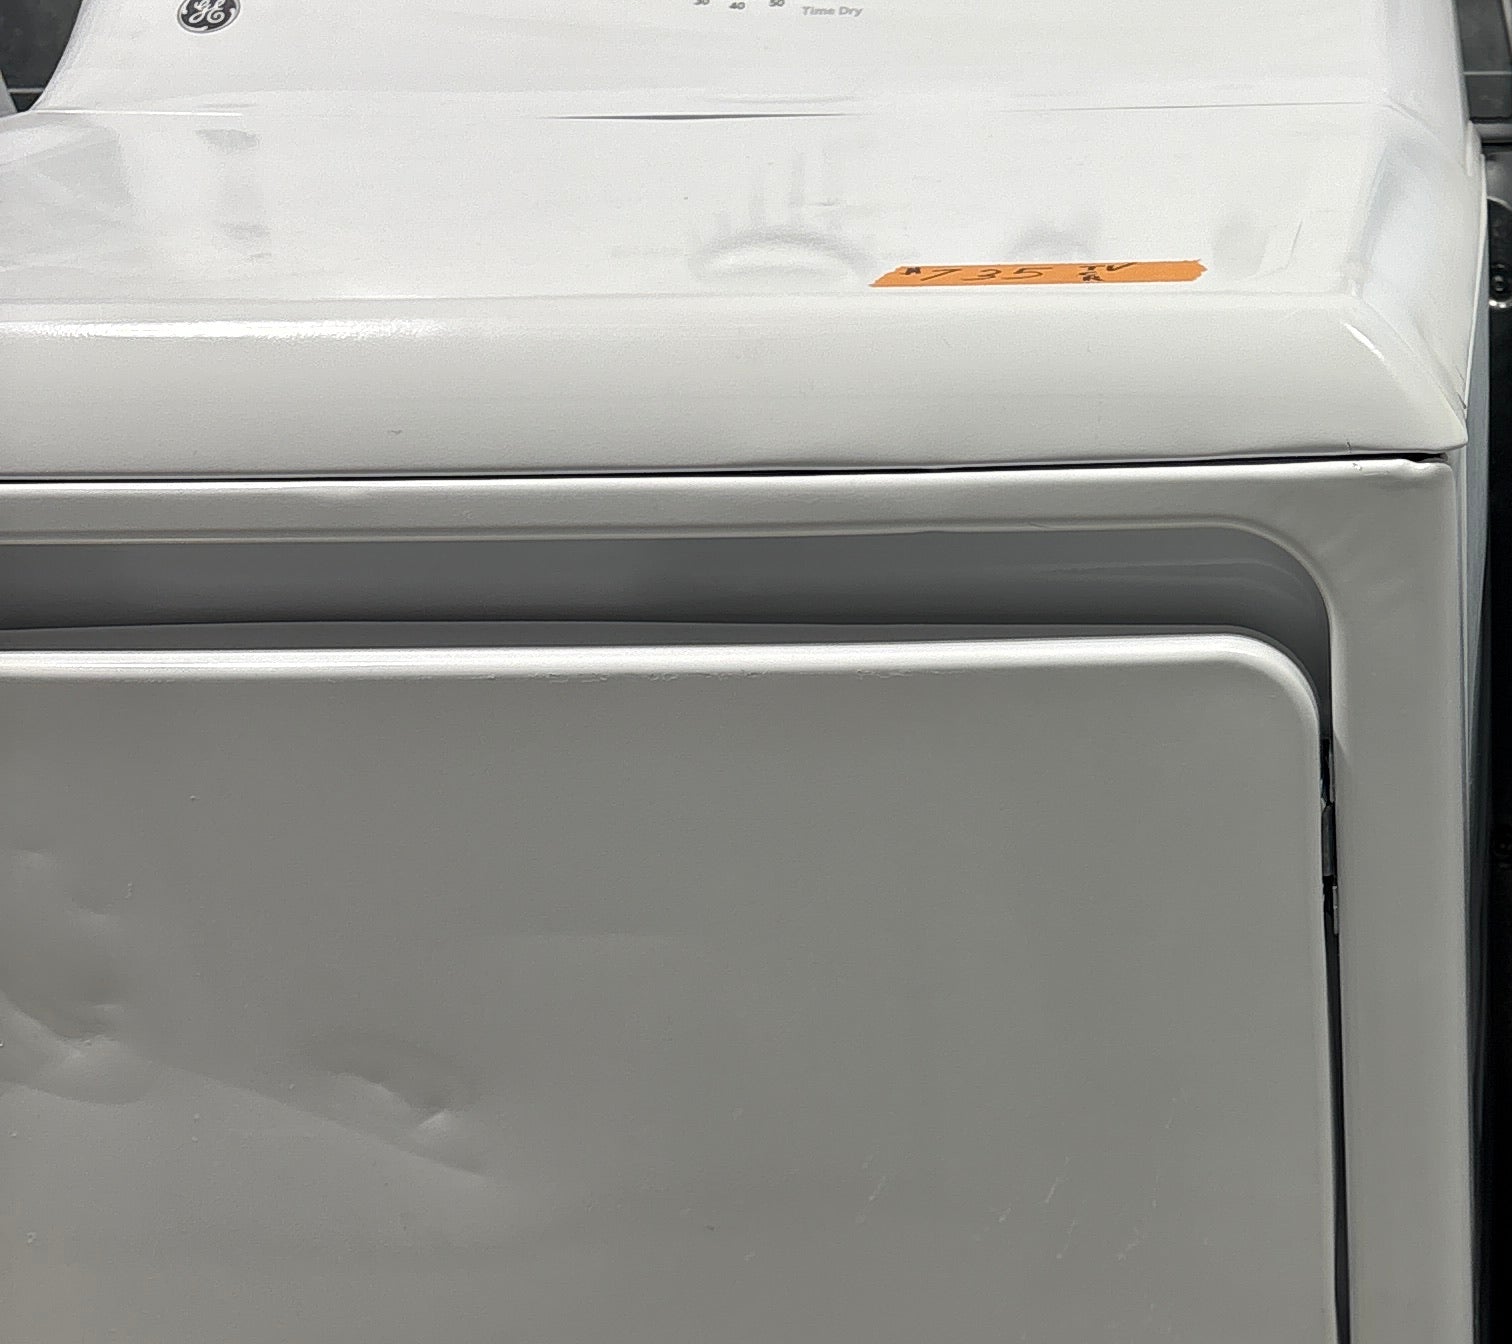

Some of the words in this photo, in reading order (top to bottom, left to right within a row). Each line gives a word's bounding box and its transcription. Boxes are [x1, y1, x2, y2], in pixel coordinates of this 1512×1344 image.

[729, 1, 745, 10] 40
[802, 6, 834, 16] Time
[839, 6, 863, 17] Dry
